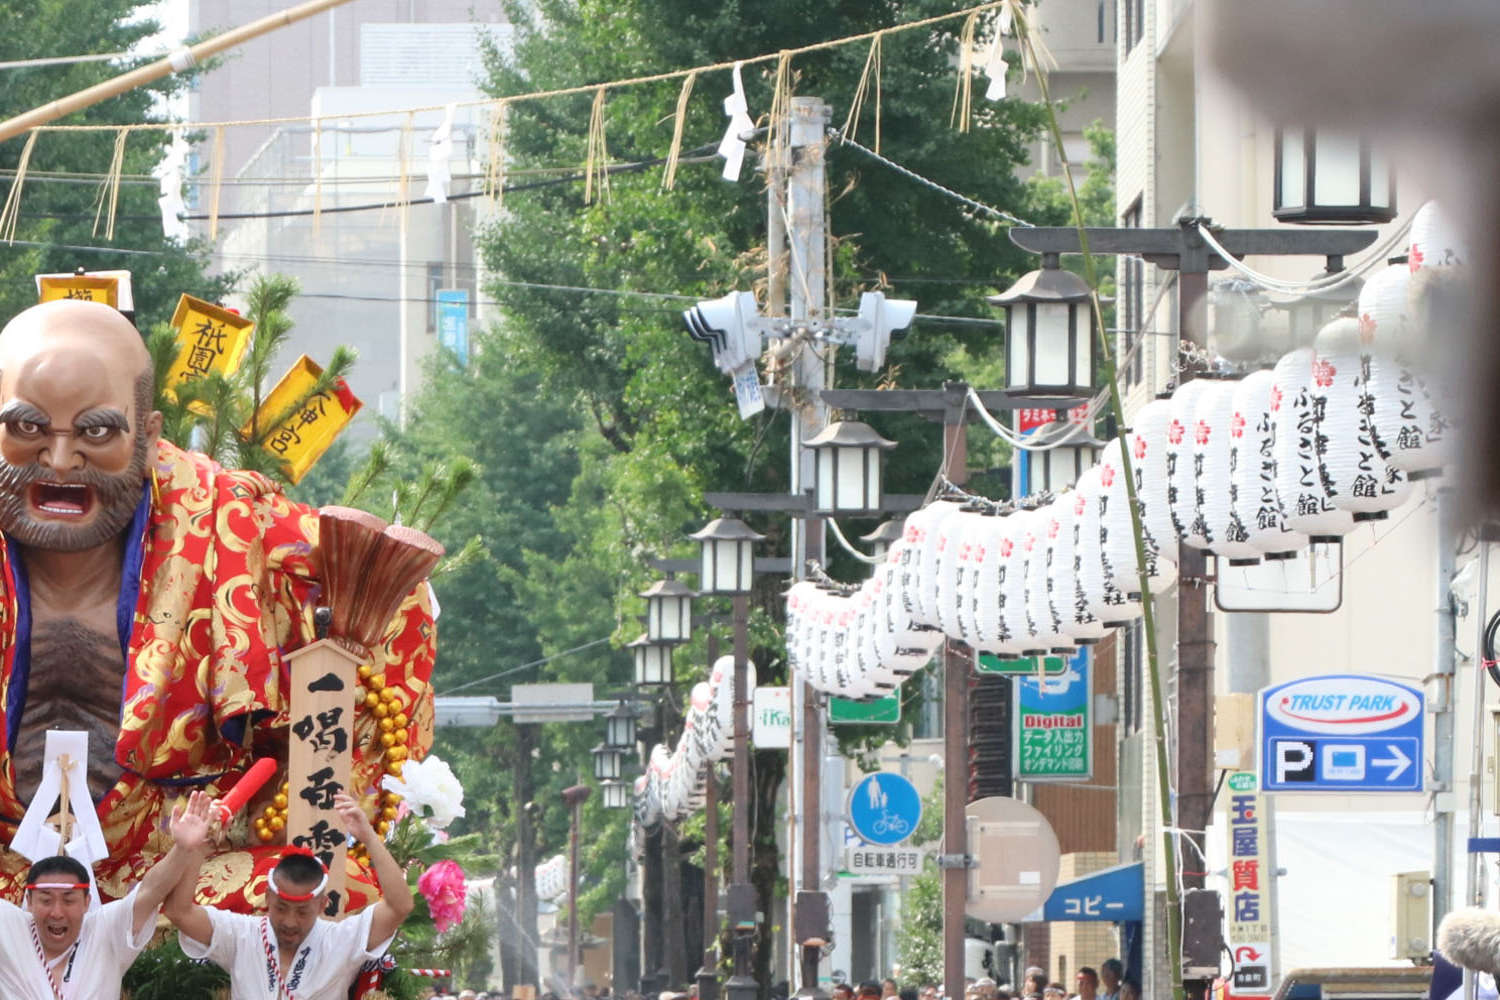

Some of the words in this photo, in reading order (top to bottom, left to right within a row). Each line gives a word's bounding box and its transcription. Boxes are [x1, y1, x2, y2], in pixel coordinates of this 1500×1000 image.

[1290, 695, 1347, 711] TRUST
[1349, 695, 1397, 711] PARK
[1025, 714, 1083, 729] Digital
[1023, 730, 1084, 744] データ入出力
[1023, 744, 1084, 758] ファイリング
[1276, 741, 1314, 784] P
[853, 852, 919, 869] 自転車通行可
[1232, 794, 1260, 923] 玉屋質店
[1064, 895, 1124, 916] コピー
